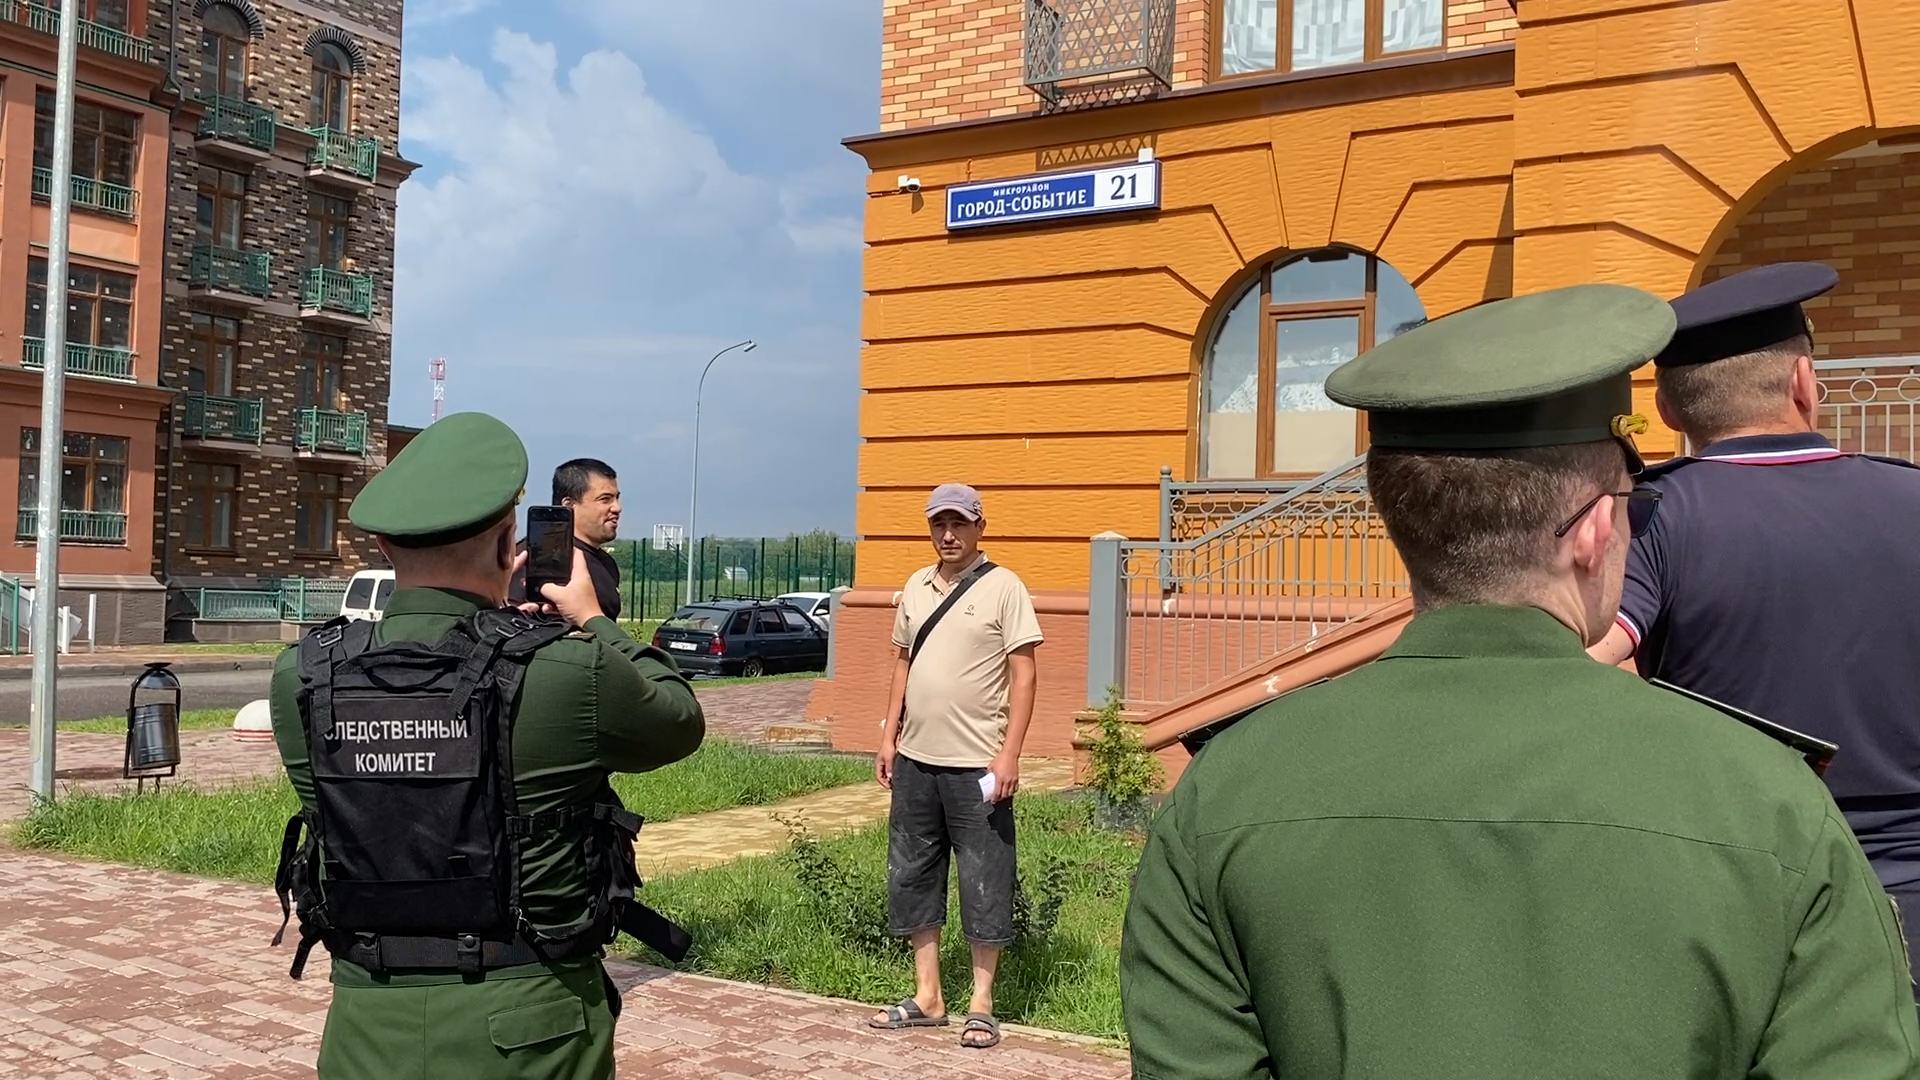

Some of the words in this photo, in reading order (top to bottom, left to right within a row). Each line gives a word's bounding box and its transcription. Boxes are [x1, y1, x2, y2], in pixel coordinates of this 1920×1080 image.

[993, 183, 1049, 197] МИКРОРАЙОН
[1110, 173, 1138, 201] 21
[957, 189, 1087, 219] ГОРОД-СОБЫТИЕ
[355, 752, 436, 773] КОМИТЕТ
